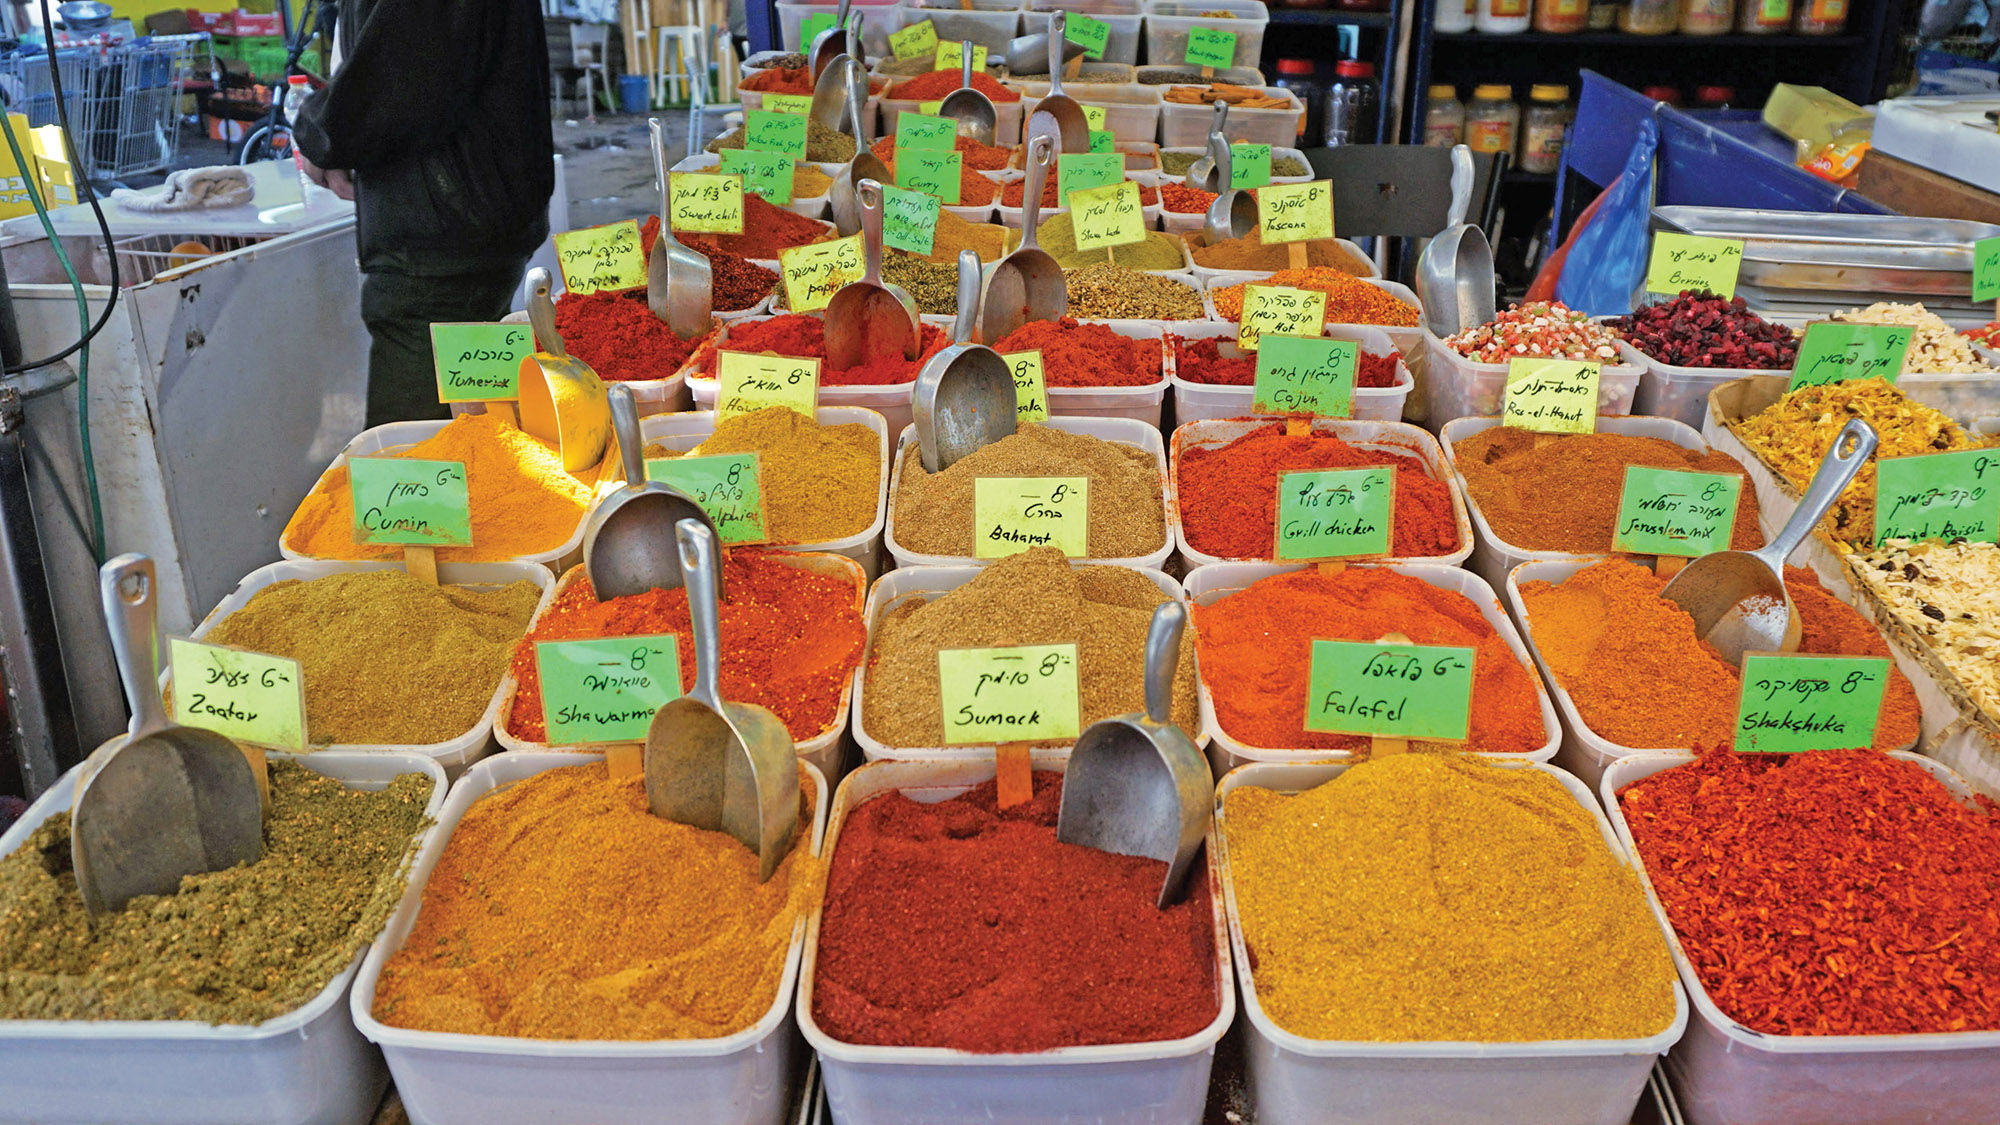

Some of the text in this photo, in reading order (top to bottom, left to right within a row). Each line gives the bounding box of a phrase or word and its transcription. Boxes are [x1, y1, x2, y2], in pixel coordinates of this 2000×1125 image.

[909, 176, 939, 194] Curry
[1267, 217, 1306, 231] Toscana
[1669, 271, 1710, 288] Berries
[1273, 389, 1318, 410] Cajun
[363, 507, 428, 532] Cumin
[1283, 517, 1376, 540] Grill chicken
[988, 524, 1052, 546] Baharat
[188, 693, 258, 722] Zaatar
[953, 704, 1040, 726] Sumack
[1322, 690, 1408, 721] Falafel
[1742, 710, 1846, 734] Shakshuka
